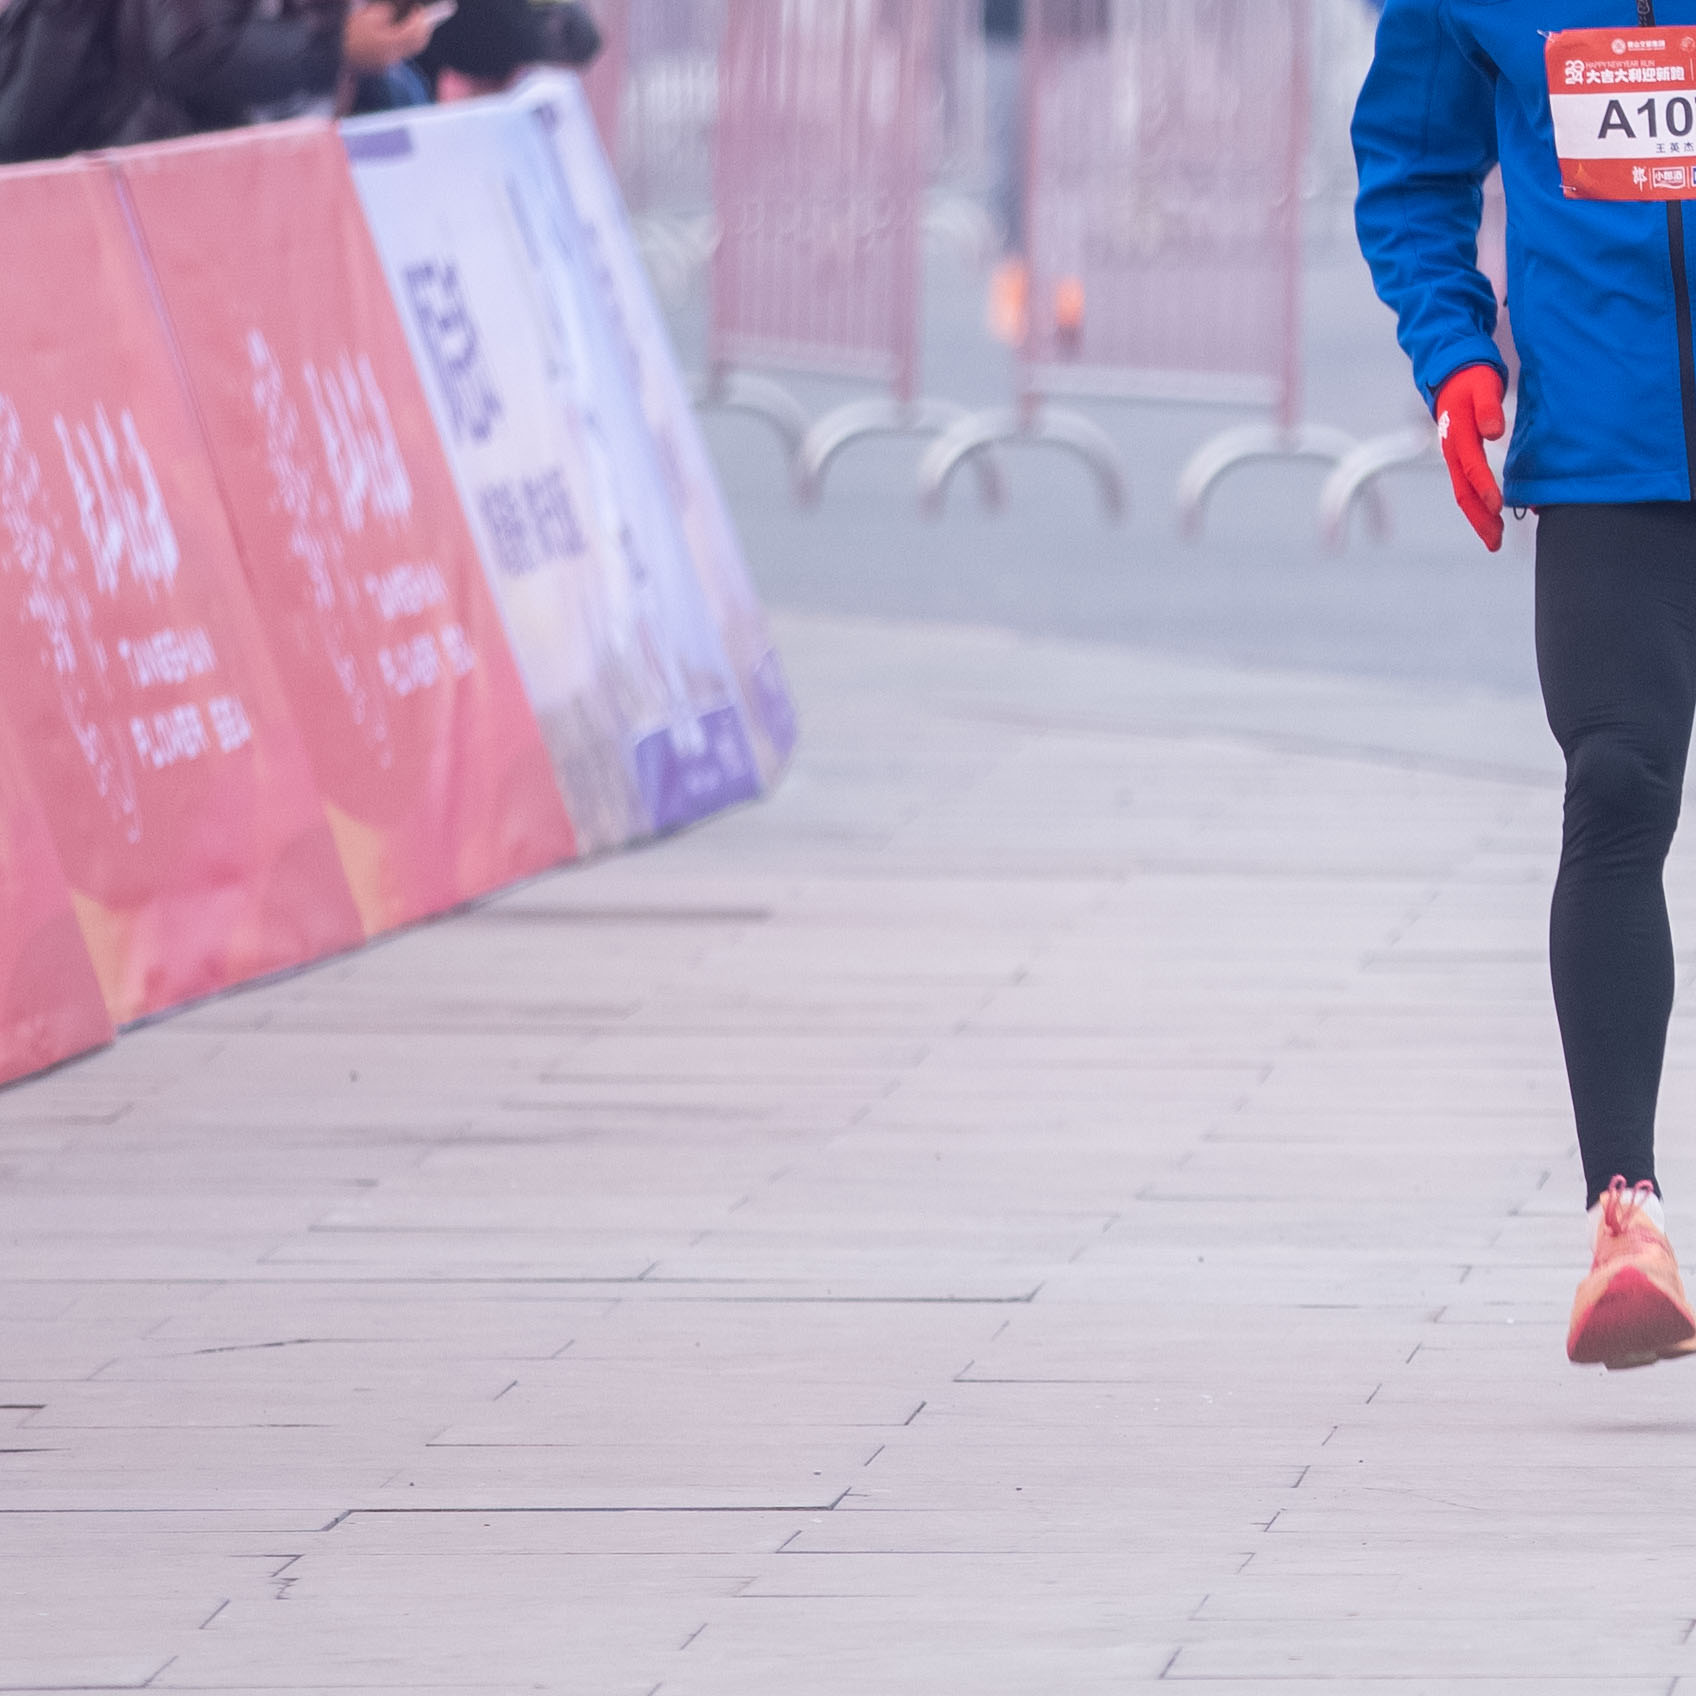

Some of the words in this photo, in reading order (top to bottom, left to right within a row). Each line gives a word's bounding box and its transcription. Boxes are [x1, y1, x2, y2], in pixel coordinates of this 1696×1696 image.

[1586, 66, 1685, 84] 大吉大利迎新跑
[1656, 142, 1694, 154] 王英杰
